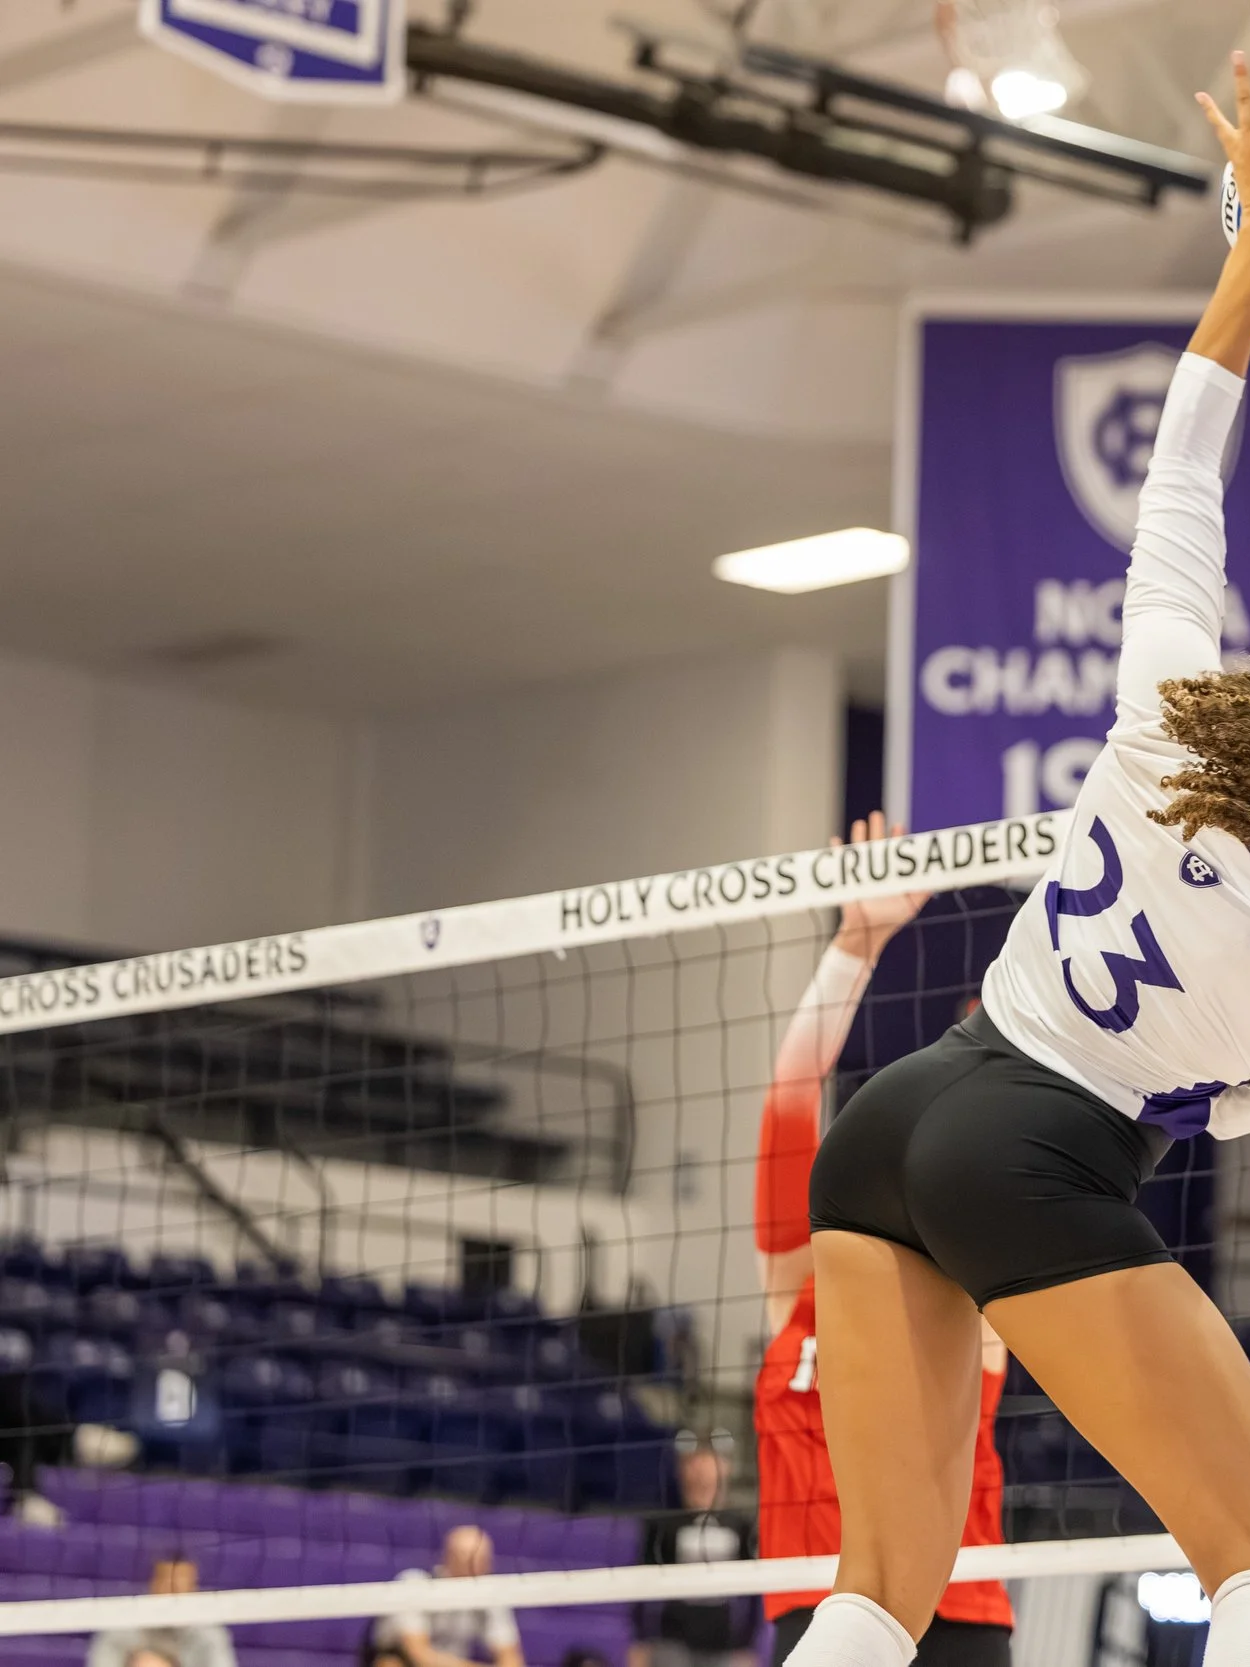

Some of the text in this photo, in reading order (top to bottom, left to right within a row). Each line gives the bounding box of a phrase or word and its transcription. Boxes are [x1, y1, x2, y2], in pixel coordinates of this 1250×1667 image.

[921, 647, 1118, 715] CHAM
[561, 816, 1057, 931] HOLY CROSS CRUSADERS
[1045, 815, 1185, 1033] 23
[0, 936, 309, 1018] CROSS CRUSADERS
